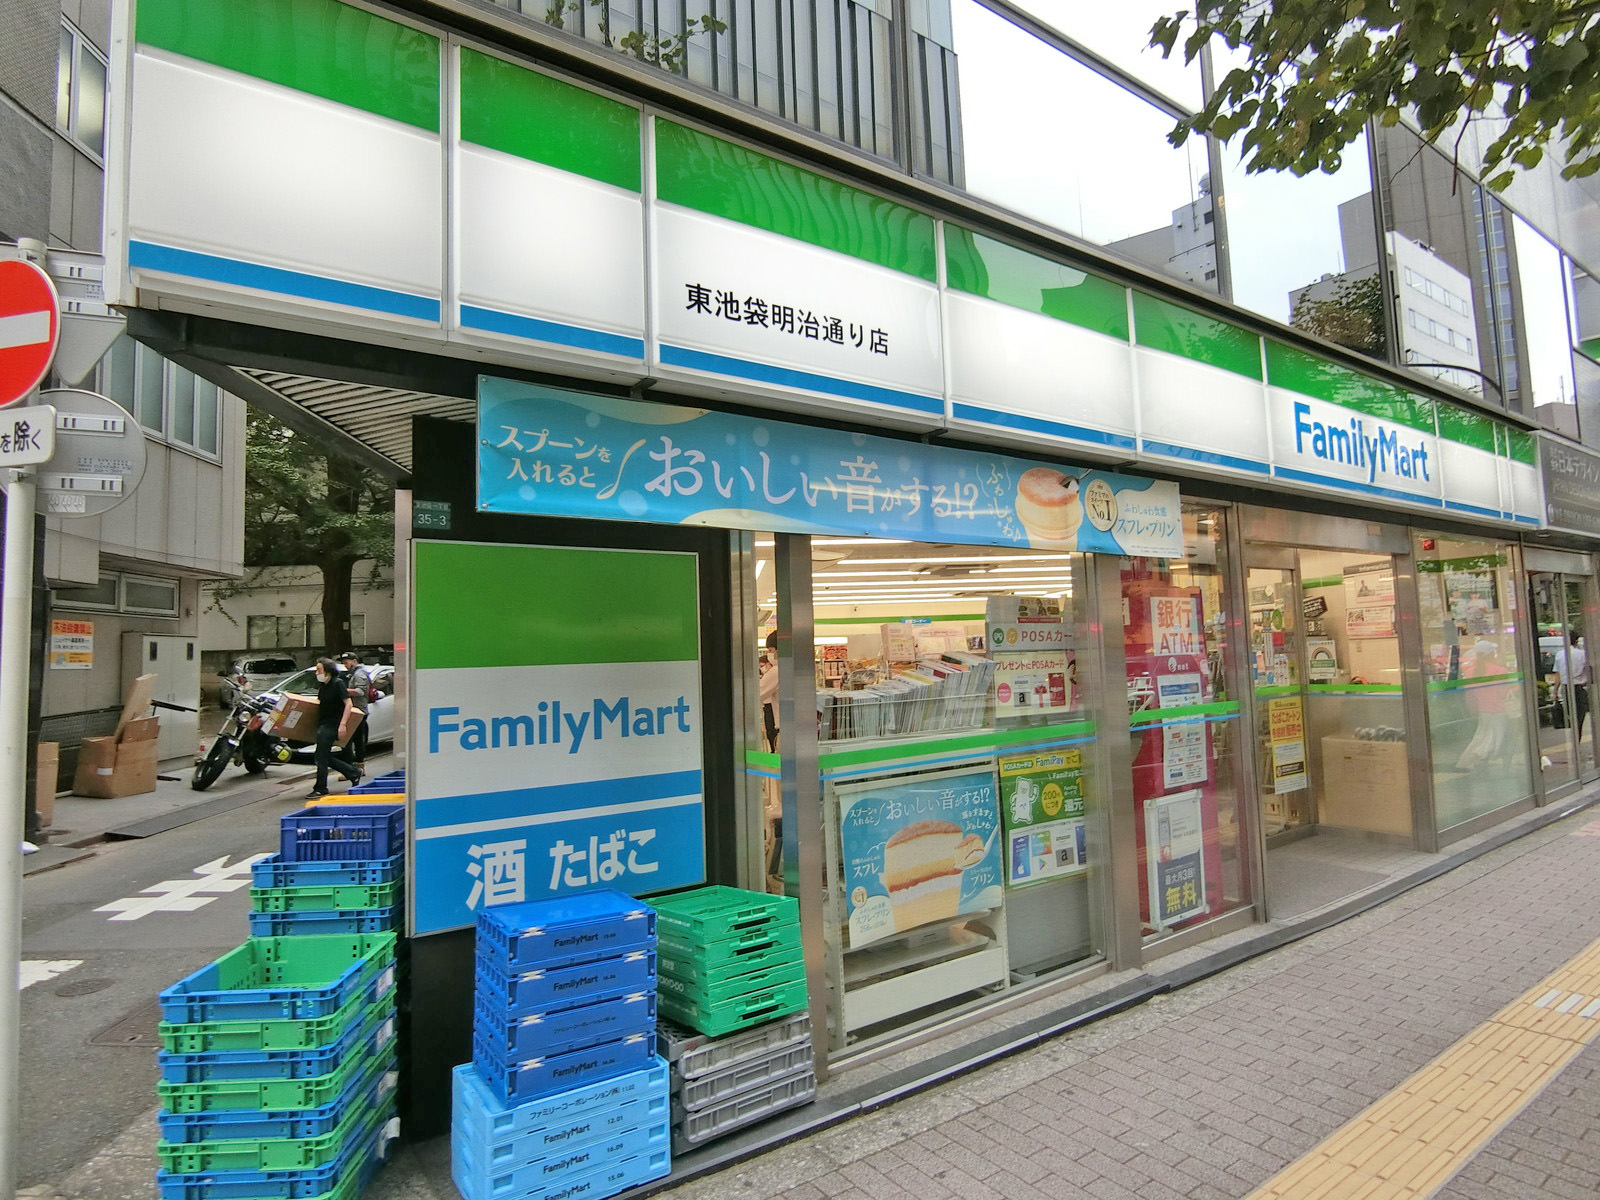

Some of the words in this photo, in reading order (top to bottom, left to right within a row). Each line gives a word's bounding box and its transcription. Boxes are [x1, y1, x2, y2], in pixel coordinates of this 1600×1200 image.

[685, 283, 889, 356] 東池袋明治通り店
[0, 420, 41, 453] を除く
[497, 425, 611, 463] スプーンを
[1293, 401, 1430, 483] FamilyMart
[507, 457, 596, 488] 入れると
[644, 435, 979, 520] おいしい音がする!?
[417, 513, 447, 526] 35-3
[1157, 599, 1193, 629] 銀行
[1159, 632, 1194, 654] ATM
[429, 696, 691, 755] FamilyMart
[1035, 756, 1064, 768] FamiPay
[886, 787, 990, 820] おいしい音がする!?
[466, 838, 528, 911] 酒
[549, 827, 659, 891] たばこ
[853, 862, 880, 879] スフレ
[1166, 879, 1197, 914] 無料
[553, 933, 599, 948] FamilyMart
[553, 975, 598, 991] FamilyMart
[552, 1060, 598, 1078] FamilyMart
[543, 1124, 591, 1144] FamilyMart
[543, 1152, 590, 1174] FamilyMart
